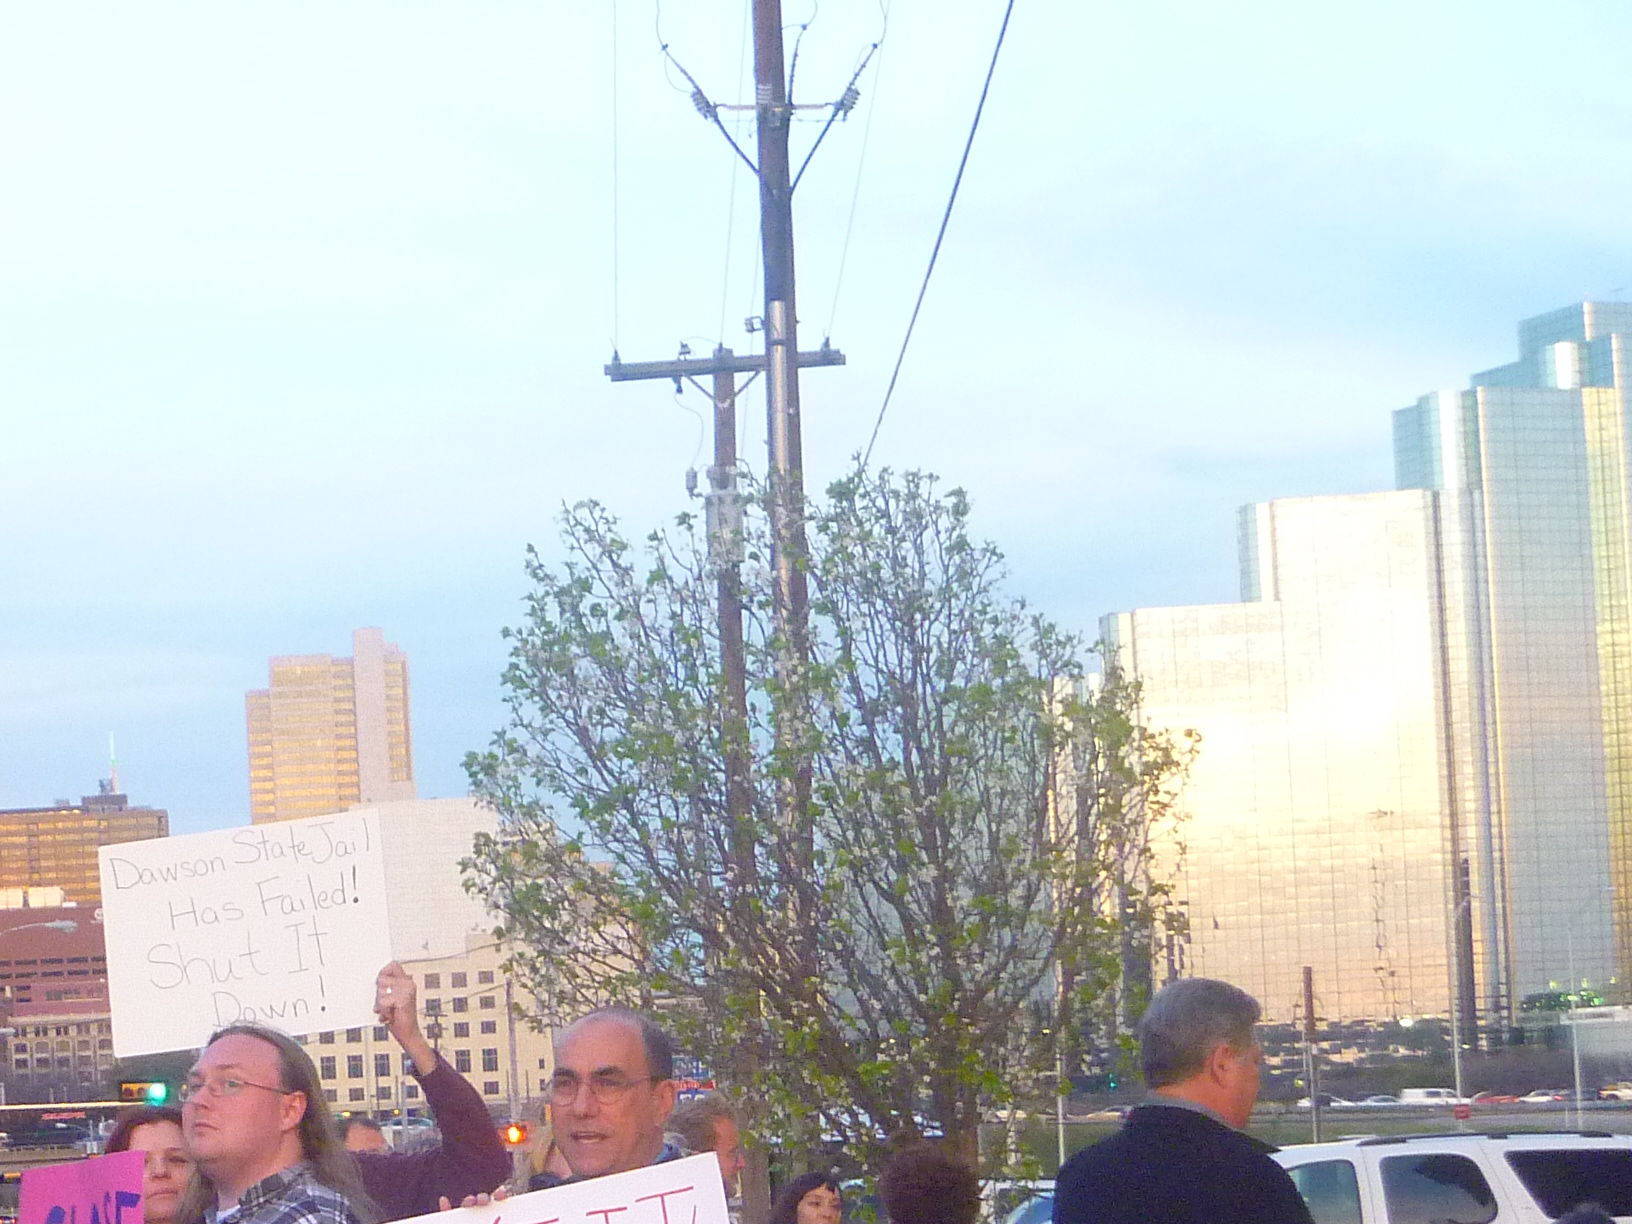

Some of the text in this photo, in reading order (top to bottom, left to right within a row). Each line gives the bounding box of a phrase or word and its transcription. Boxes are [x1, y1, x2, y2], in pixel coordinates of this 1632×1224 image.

[109, 818, 370, 890] Dawson State Jail
[168, 865, 359, 930] Has Failed!
[147, 914, 328, 990] Shut It
[212, 974, 326, 1028] Down!
